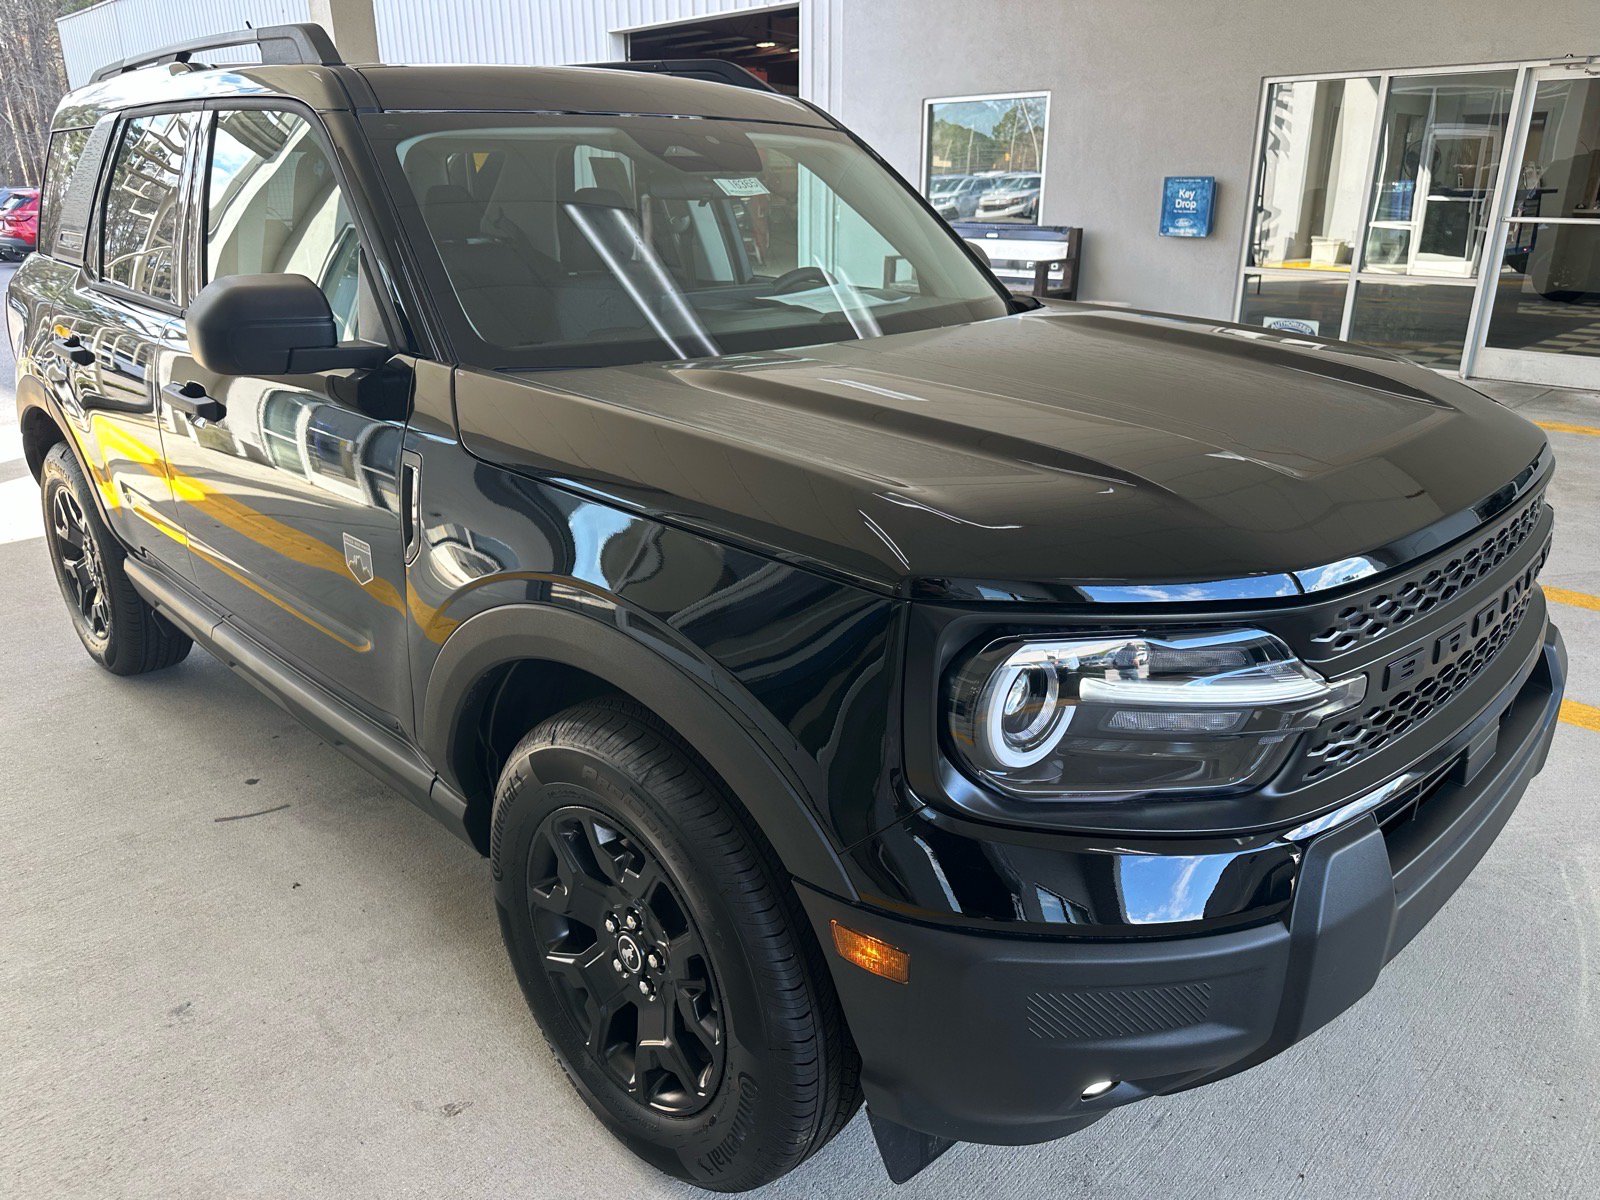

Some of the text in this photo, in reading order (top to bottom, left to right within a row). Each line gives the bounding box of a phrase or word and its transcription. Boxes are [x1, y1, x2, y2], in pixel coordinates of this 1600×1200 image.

[1175, 199, 1197, 210] Drop
[1178, 189, 1196, 200] Key
[492, 776, 518, 881] Continental
[706, 1071, 760, 1173] Continental
